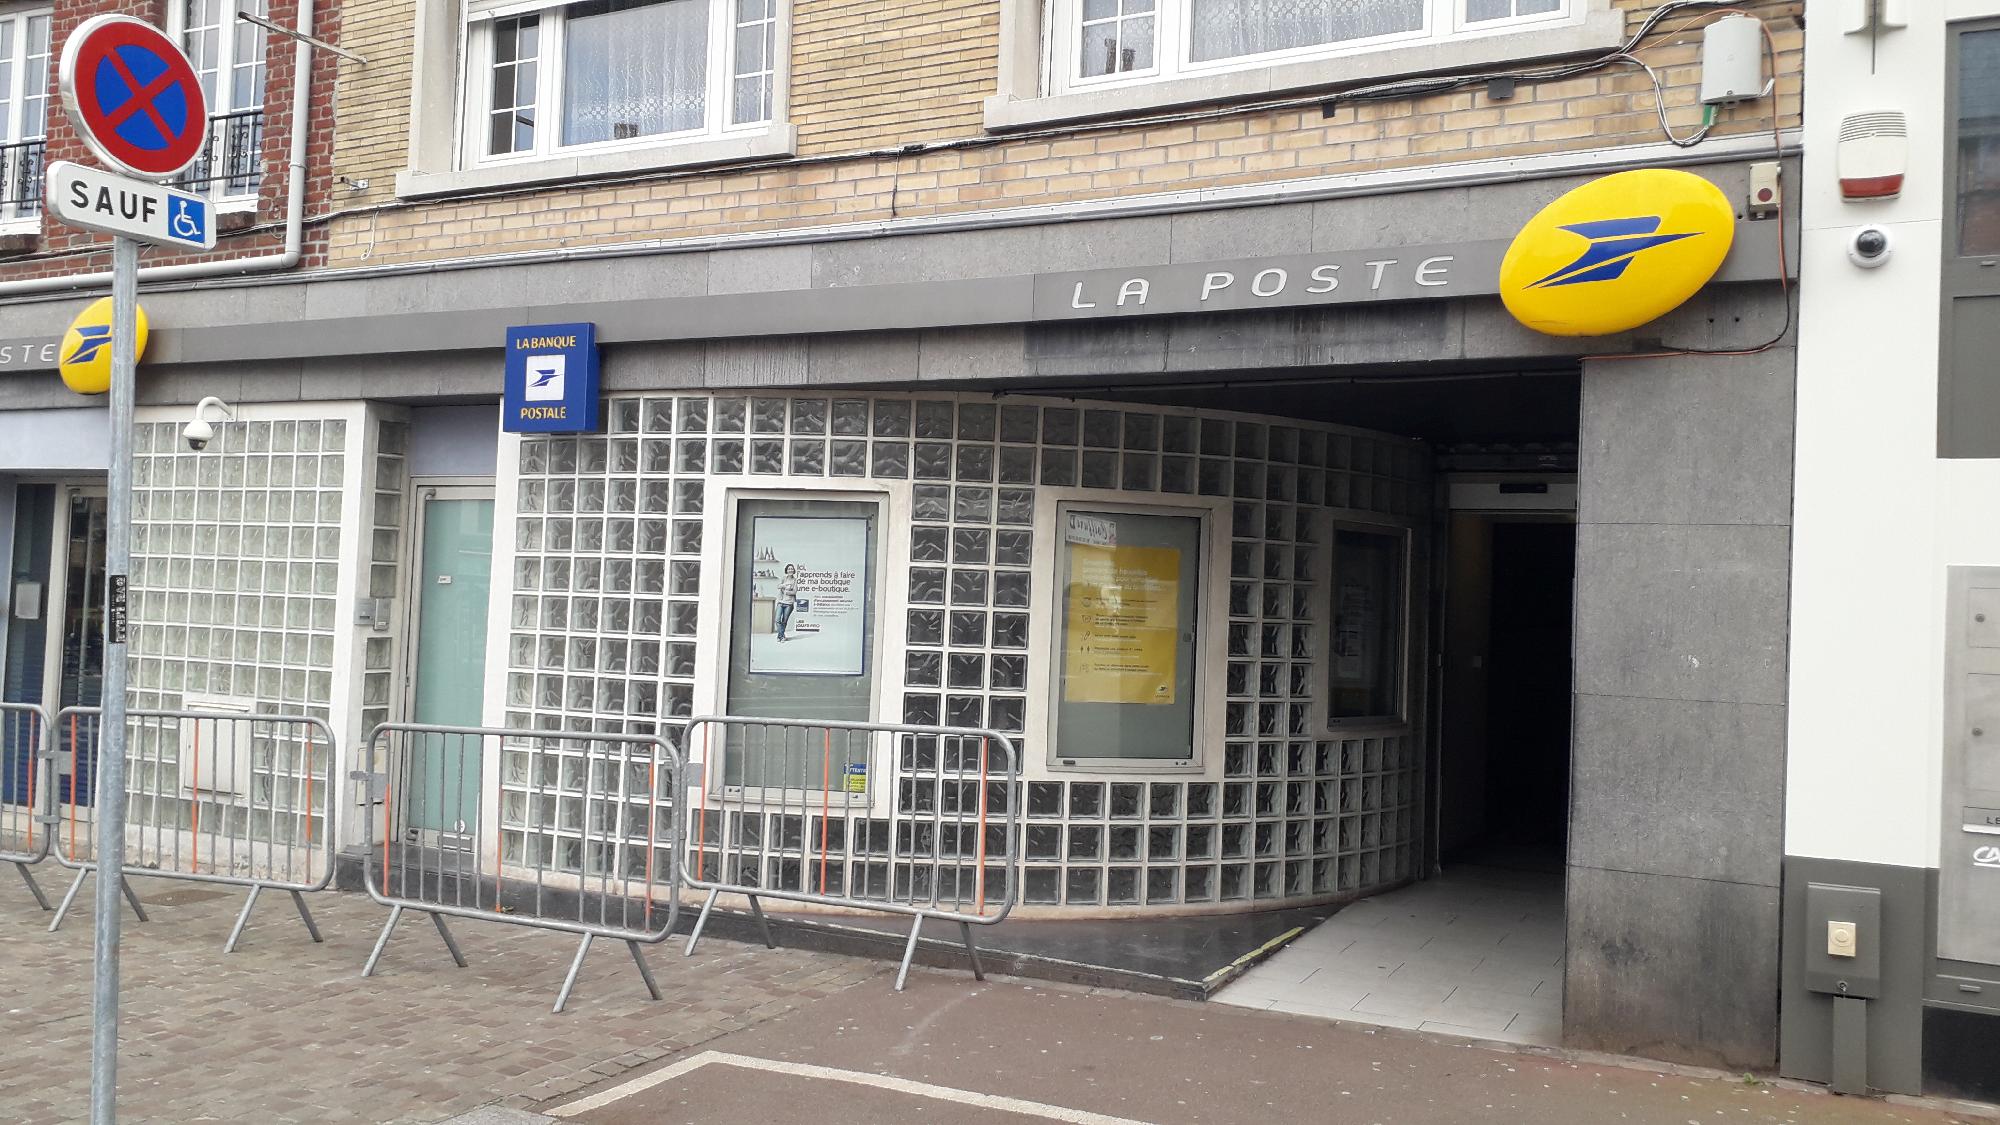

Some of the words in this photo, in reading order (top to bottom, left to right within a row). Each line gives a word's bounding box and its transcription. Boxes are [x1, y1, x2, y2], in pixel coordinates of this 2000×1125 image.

[70, 179, 159, 223] SAUF
[1071, 278, 1151, 309] LA
[1200, 255, 1455, 302] POSTE
[516, 338, 529, 349] LA
[531, 335, 577, 349] BANQUE
[520, 406, 567, 420] POSTALE
[820, 578, 851, 586] boutique
[840, 571, 856, 579] faire
